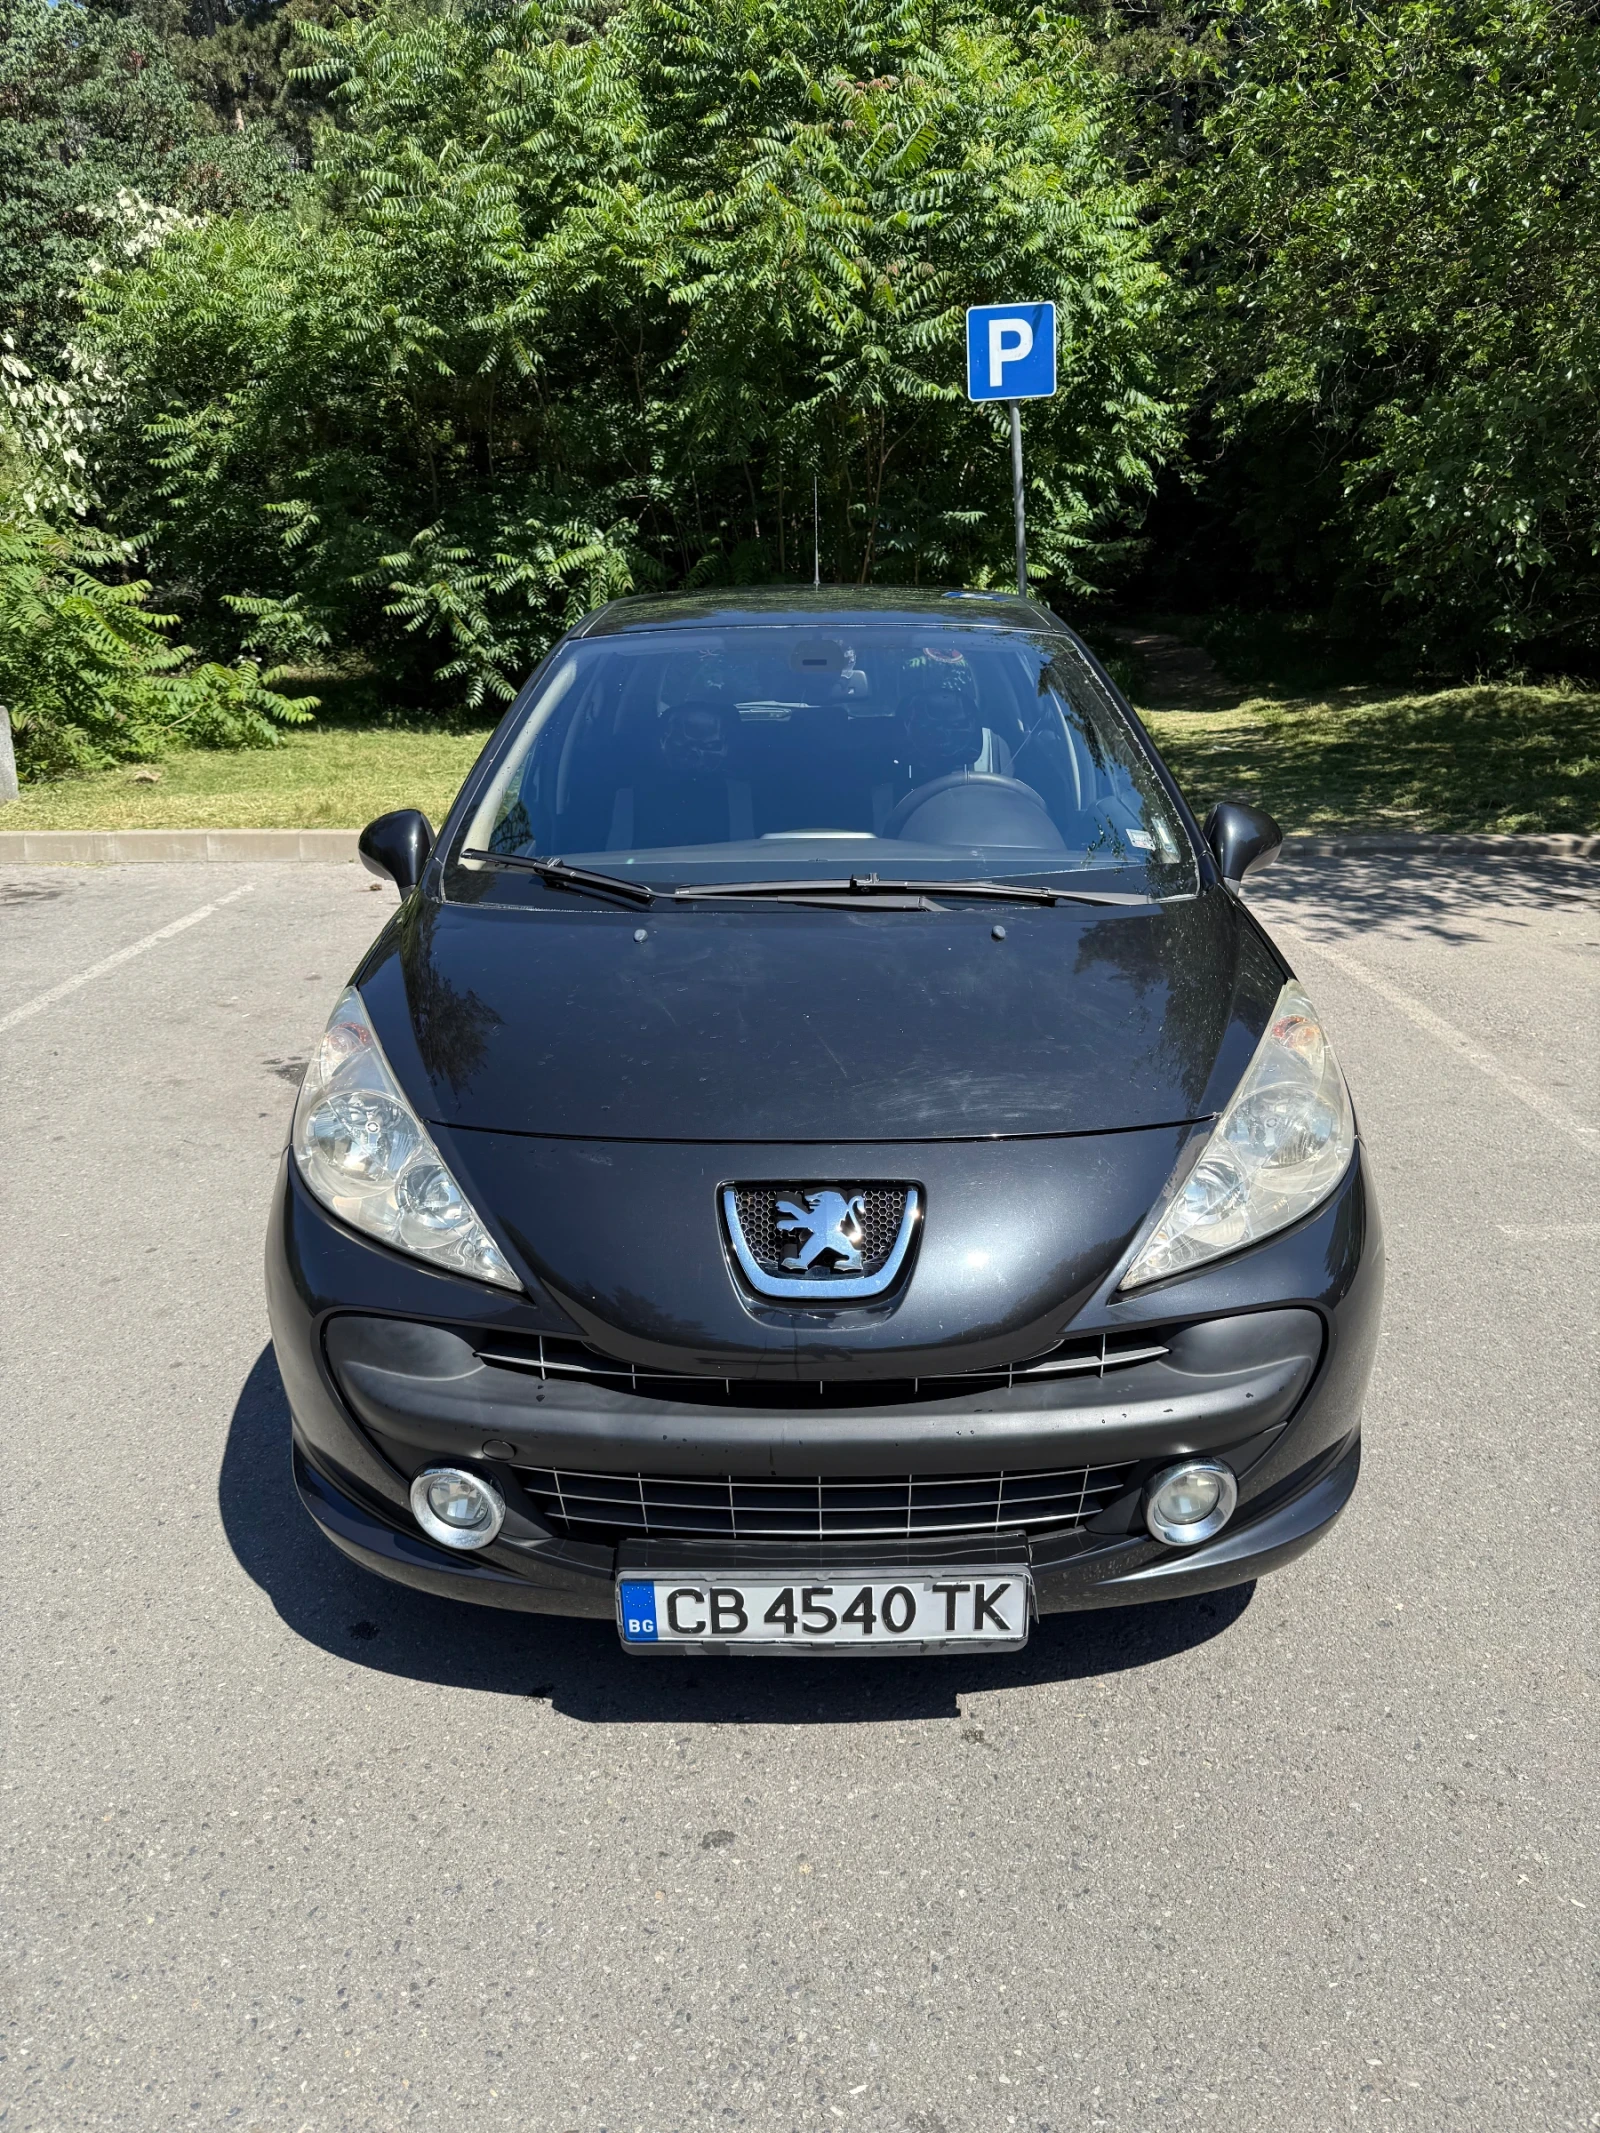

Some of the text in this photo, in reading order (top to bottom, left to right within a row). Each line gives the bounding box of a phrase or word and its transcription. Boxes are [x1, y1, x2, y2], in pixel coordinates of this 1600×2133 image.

[988, 318, 1033, 387] P
[629, 1619, 654, 1633] BG
[667, 1583, 1011, 1634] CB 4540 TK
